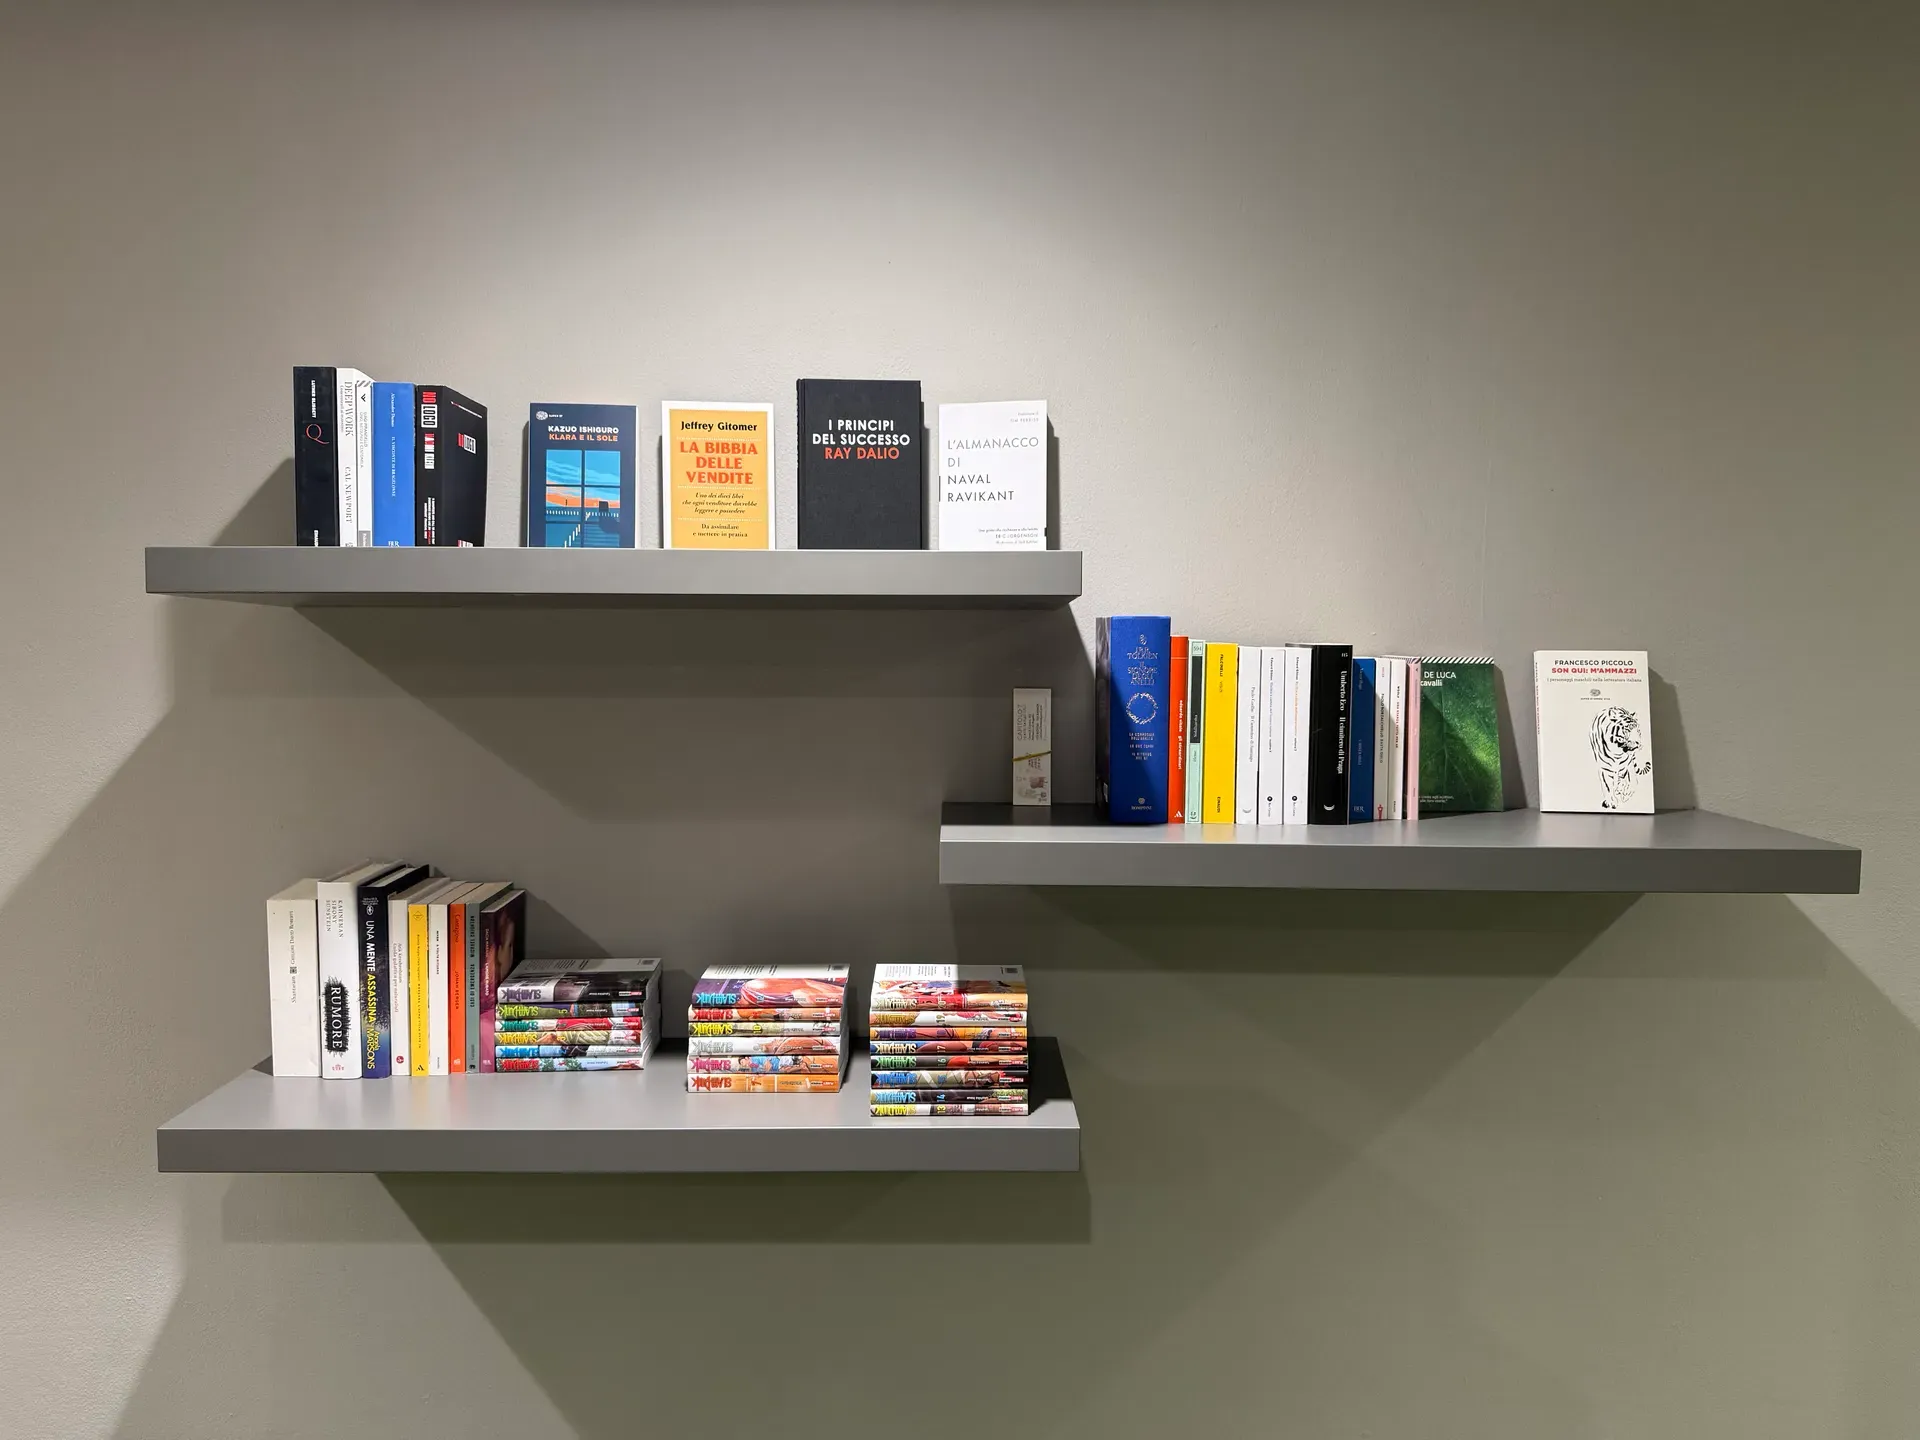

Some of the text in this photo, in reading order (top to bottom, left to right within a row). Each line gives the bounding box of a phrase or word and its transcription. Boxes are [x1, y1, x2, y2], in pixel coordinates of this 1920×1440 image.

[344, 381, 355, 437] DEEP WORK
[422, 392, 437, 427] NO LOGO
[548, 425, 619, 434] KAZUO ISHIGURO
[681, 420, 758, 432] Jeffrey Gitomer
[828, 419, 894, 431] I PRINCIPI
[306, 424, 330, 445] Q
[549, 433, 577, 441] KLARA
[587, 434, 595, 442] IL
[597, 434, 618, 442] SOLE
[812, 433, 911, 446] DEL SUCCESSO
[680, 441, 758, 455] LA BIBBIA
[947, 436, 1039, 450] L'ALMANACCO
[824, 447, 900, 460] RAY DALIO
[696, 456, 743, 470] DELLE
[947, 456, 960, 467] DI
[685, 471, 754, 485] VENDITE
[947, 474, 991, 485] NAVAL
[344, 467, 353, 524] CAL NEWPORT
[947, 490, 1014, 503] RAVIKANT
[728, 531, 748, 539] pratica
[1126, 652, 1159, 660] TOLKIEN
[1127, 666, 1158, 674] SIGNORE
[1423, 671, 1457, 679] DE LUCA
[1590, 667, 1638, 675] M'AMMAZZI
[1339, 670, 1347, 698] Umberto
[1420, 678, 1443, 687] cavalli
[1339, 699, 1347, 711] Eco
[1338, 722, 1346, 748] cimitero
[1336, 757, 1345, 774] Praga
[365, 920, 378, 1023] UNA MENTE ASSASSINA
[330, 986, 342, 1049] RUMORE
[373, 1031, 381, 1050] Angela
[366, 1027, 375, 1070] MARSONS
